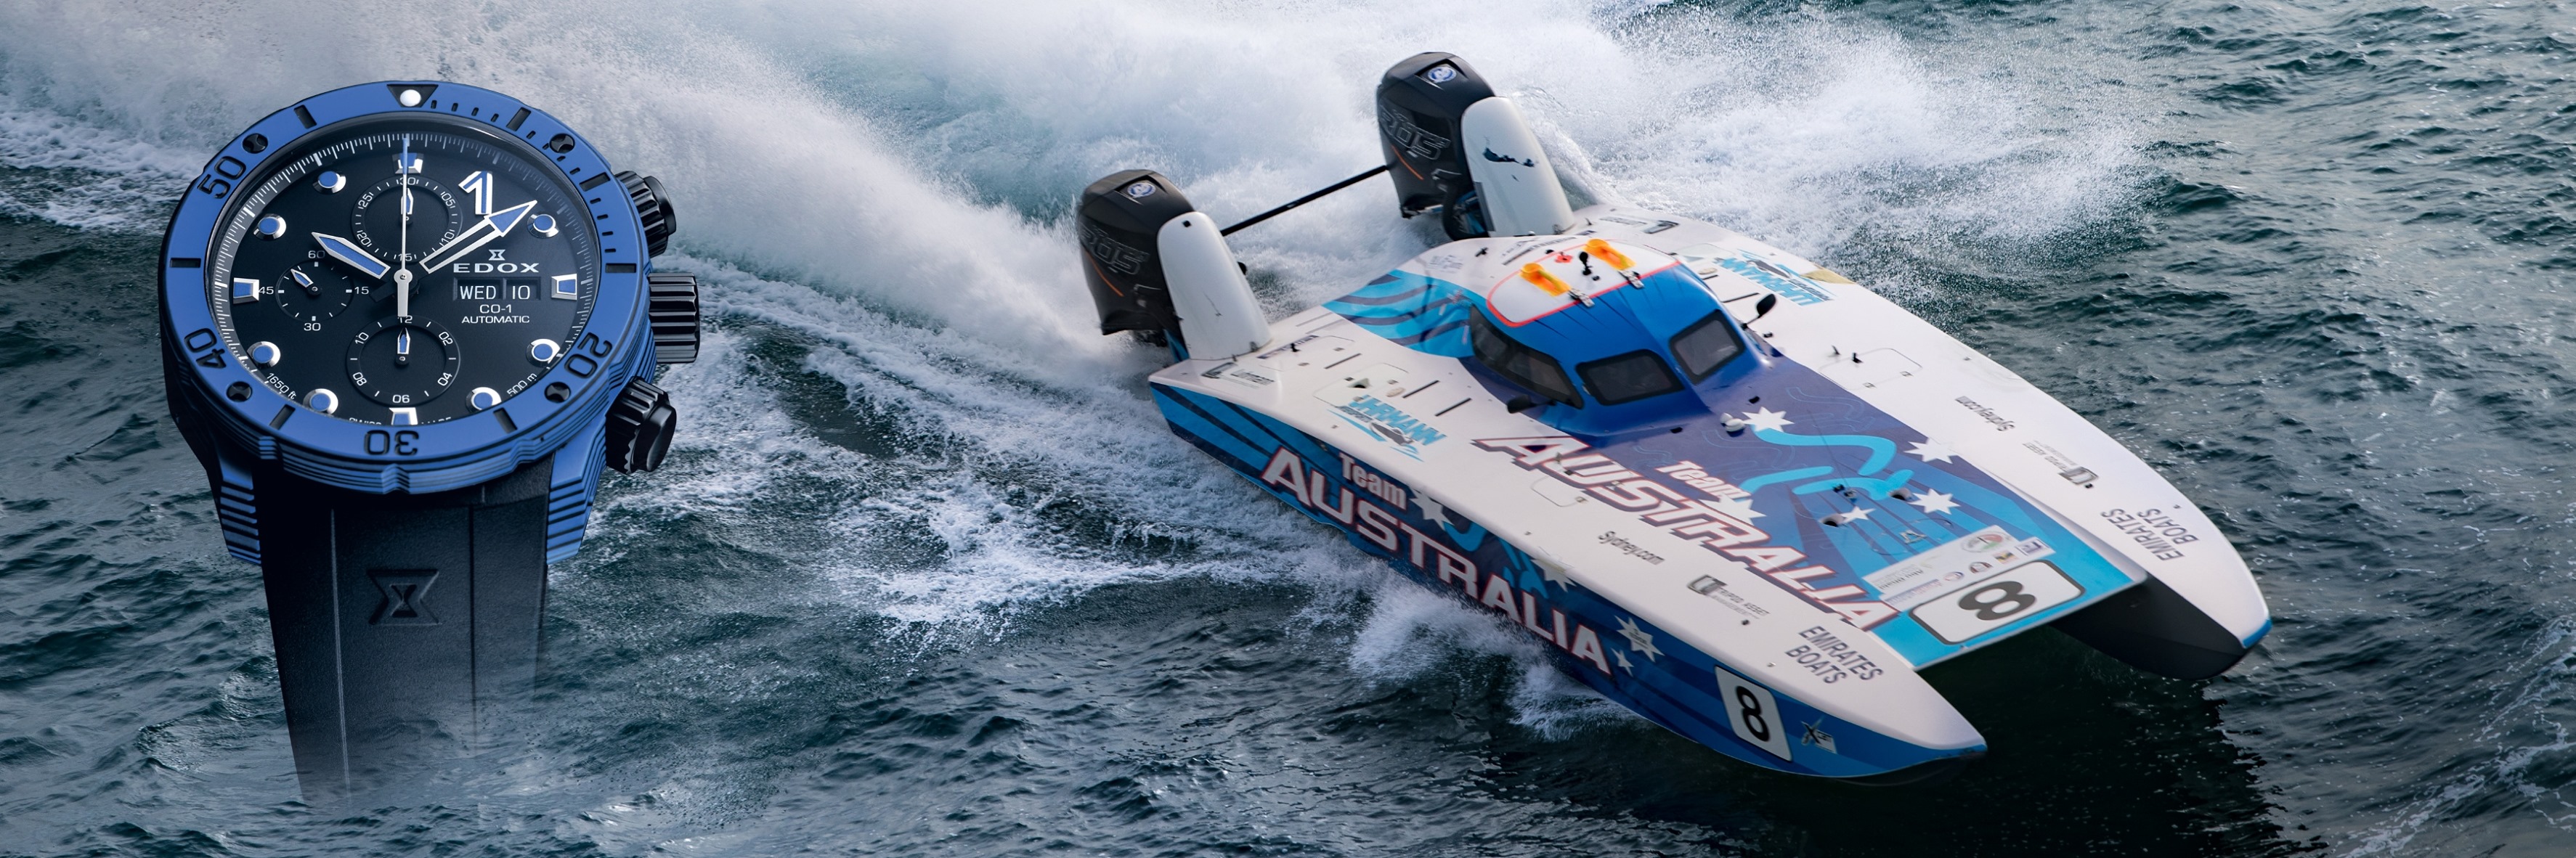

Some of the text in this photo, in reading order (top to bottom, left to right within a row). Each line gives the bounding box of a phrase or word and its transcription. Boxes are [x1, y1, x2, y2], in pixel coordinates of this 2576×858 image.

[197, 155, 246, 198] 50
[308, 250, 325, 259] 60
[453, 263, 540, 273] EDOX
[259, 286, 275, 295] 45
[354, 286, 370, 295] 15
[460, 285, 530, 300] WED 10
[397, 315, 413, 324] 12
[479, 304, 512, 314] CO-1
[304, 322, 322, 331] 30
[354, 332, 369, 345] 10
[438, 331, 453, 346] 02
[184, 328, 227, 369] 40
[564, 332, 612, 379] 20
[267, 372, 296, 400] 1650 ft
[352, 372, 367, 386] 08
[437, 372, 452, 386] 04
[506, 372, 537, 396] 500 m
[392, 394, 410, 404] 06
[365, 429, 419, 456] 30
[1338, 452, 1407, 510] Team
[1654, 459, 1752, 501] Team
[1471, 435, 1901, 631] AUSTRALIA
[2100, 508, 2185, 561] EMIRATES
[2137, 508, 2199, 545] BOATS
[1261, 446, 1612, 676] AUSTRALIA
[1598, 531, 1665, 565] Sydney.com
[1957, 581, 2036, 621] 8
[1784, 645, 1847, 684] BOATS
[1798, 625, 1884, 681] EMIRATES
[1734, 685, 1770, 742] 8
